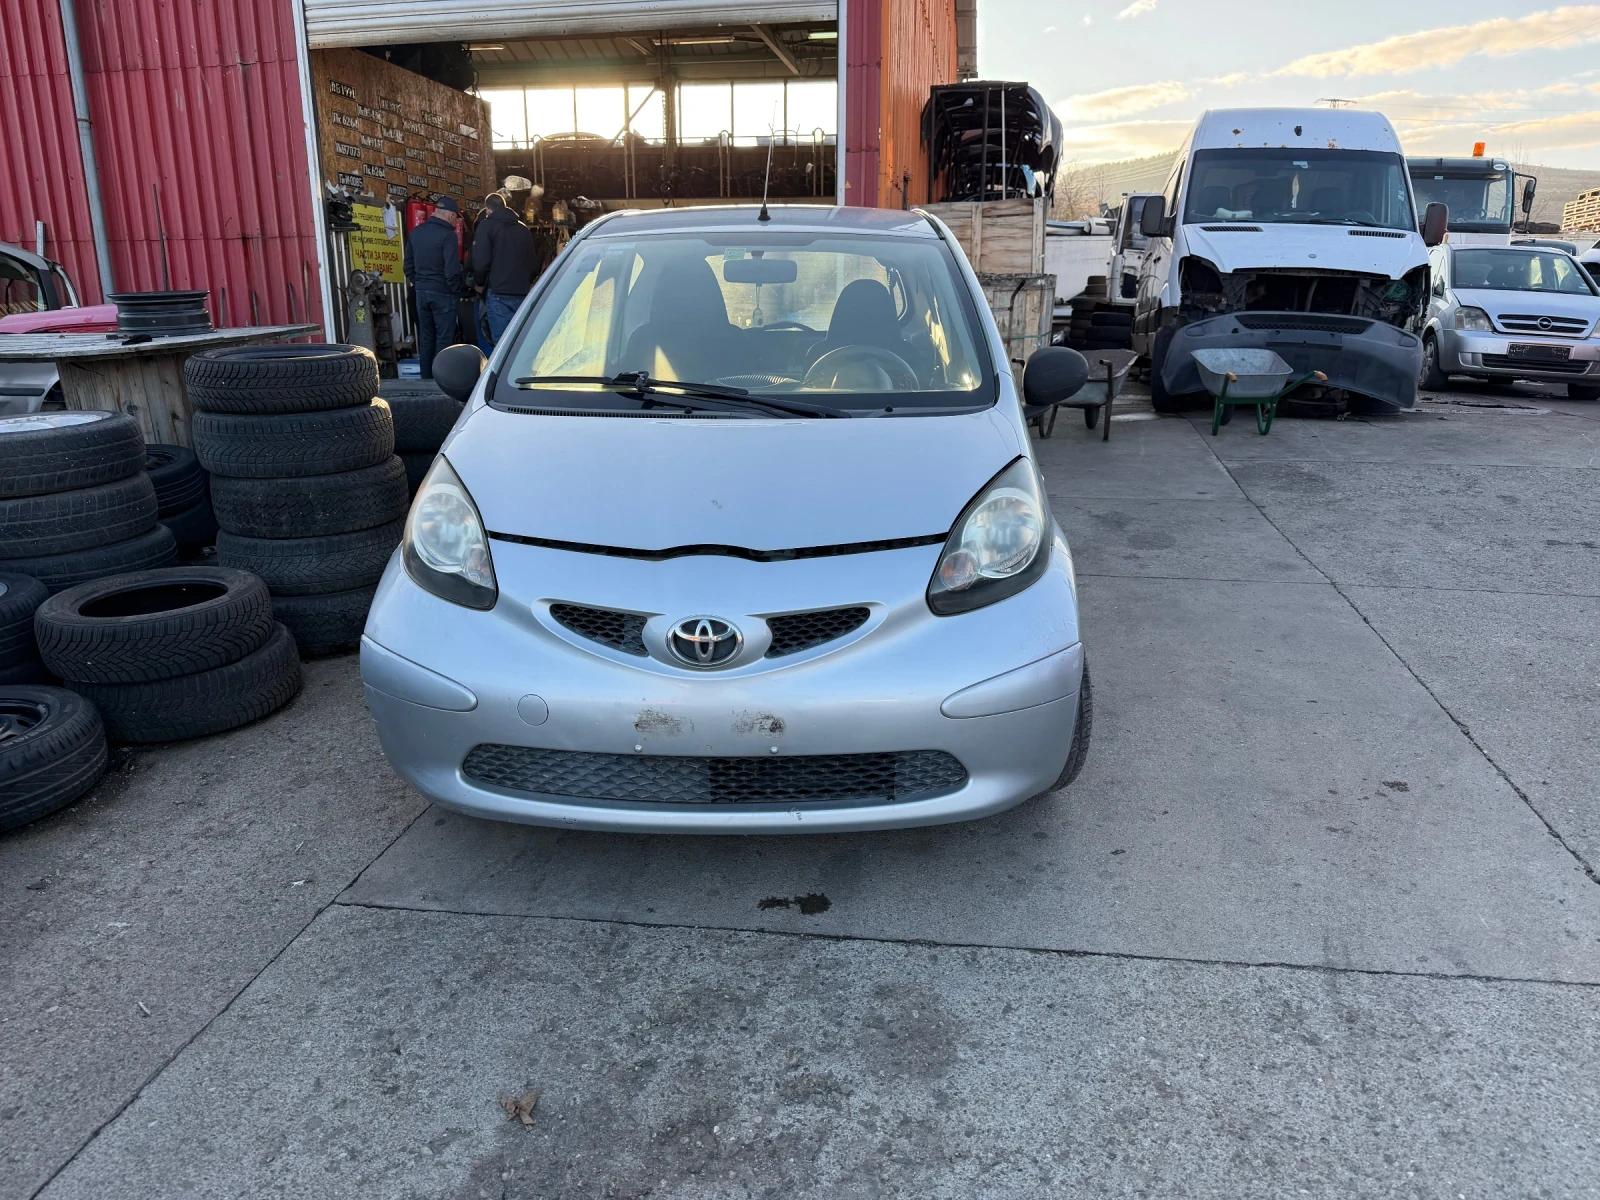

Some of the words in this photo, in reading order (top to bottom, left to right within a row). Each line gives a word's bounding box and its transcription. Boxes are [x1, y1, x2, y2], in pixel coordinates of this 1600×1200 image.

[358, 212, 373, 222] ГРЕШНО
[355, 248, 373, 260] ЧАСТИ
[374, 250, 381, 260] ЗА
[381, 251, 399, 262] ПРОБА
[364, 262, 371, 272] НЕ
[372, 263, 393, 273] ДАВАМЕ
